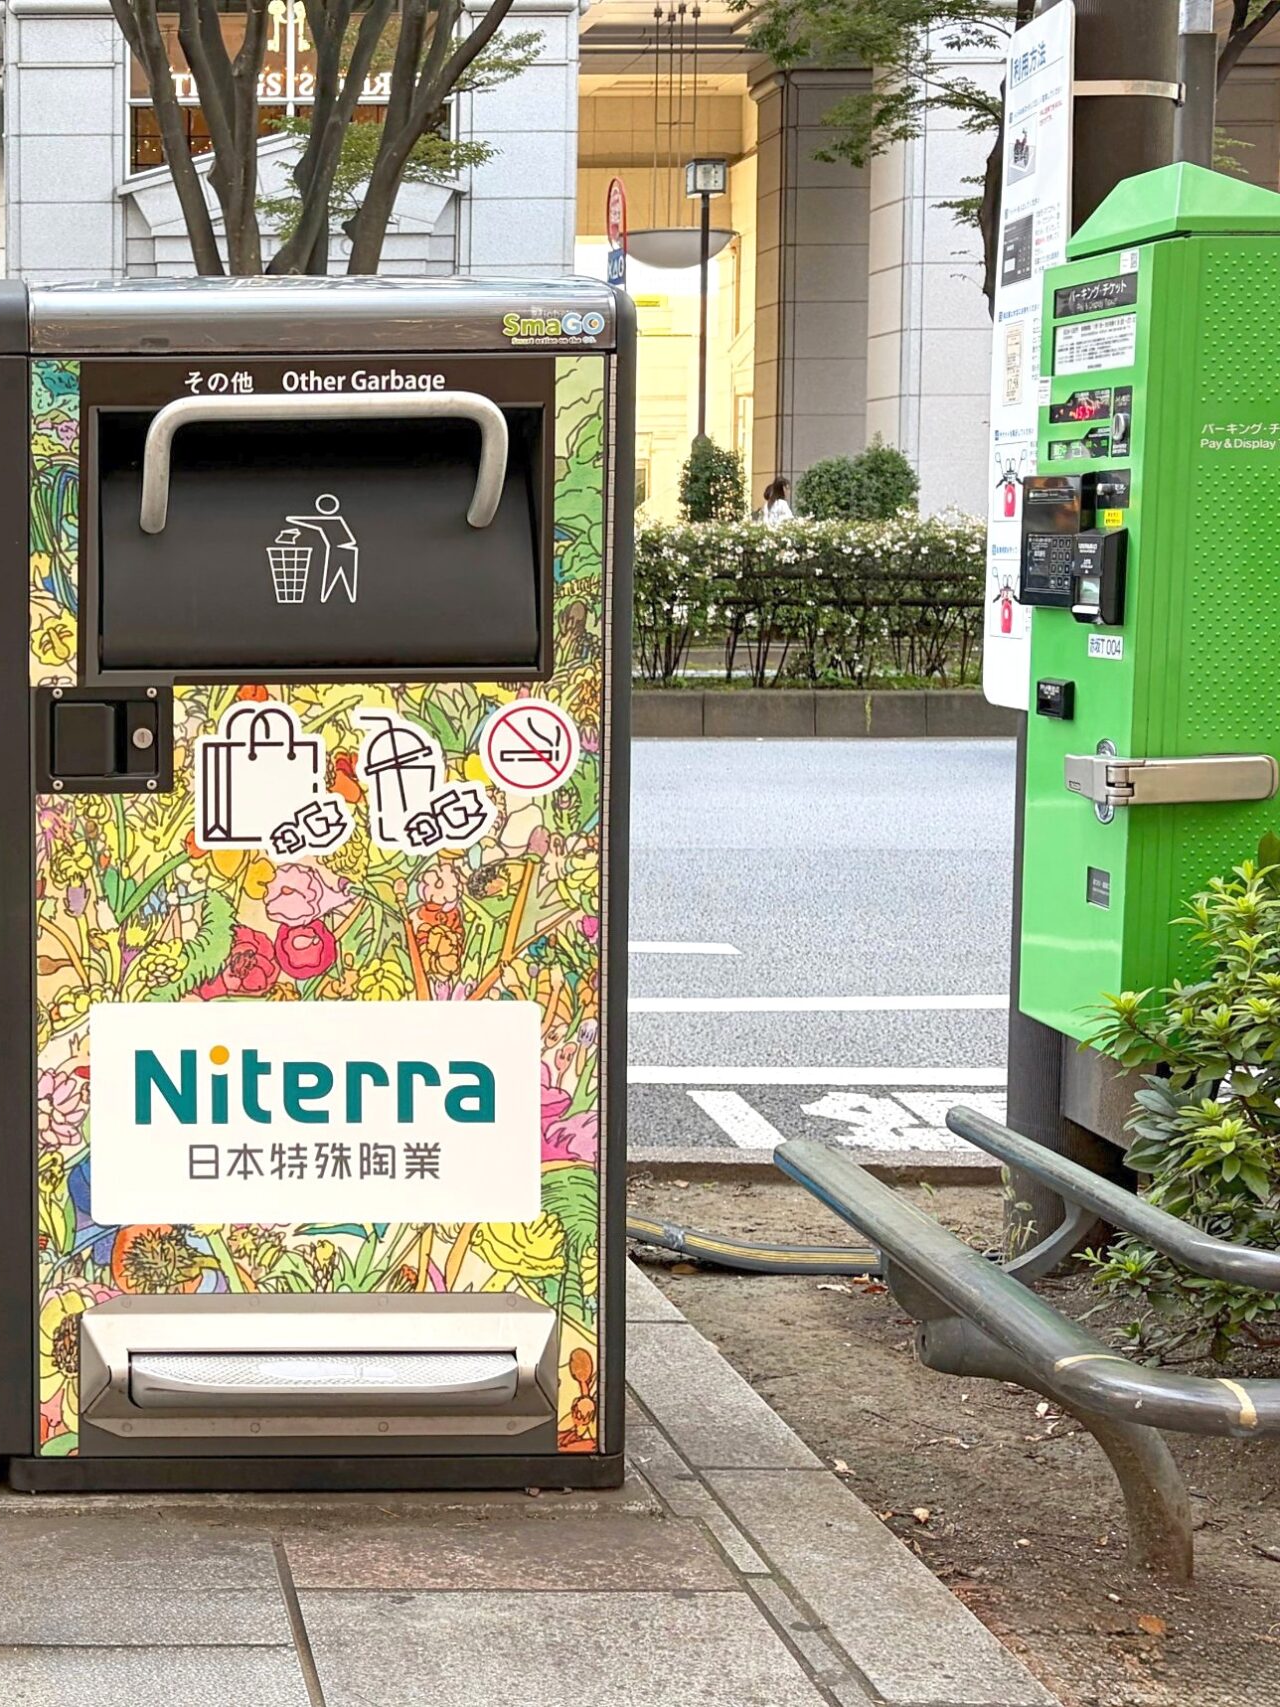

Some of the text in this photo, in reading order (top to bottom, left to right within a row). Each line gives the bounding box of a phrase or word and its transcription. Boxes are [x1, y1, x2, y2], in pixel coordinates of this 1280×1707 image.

[502, 312, 605, 337] SmaGO
[184, 371, 254, 394] その他
[282, 368, 446, 392] Other Garbage
[1200, 438, 1276, 450] Pay & Display
[135, 1045, 496, 1126] Niterra
[188, 1142, 442, 1181] 日本特殊陶業
